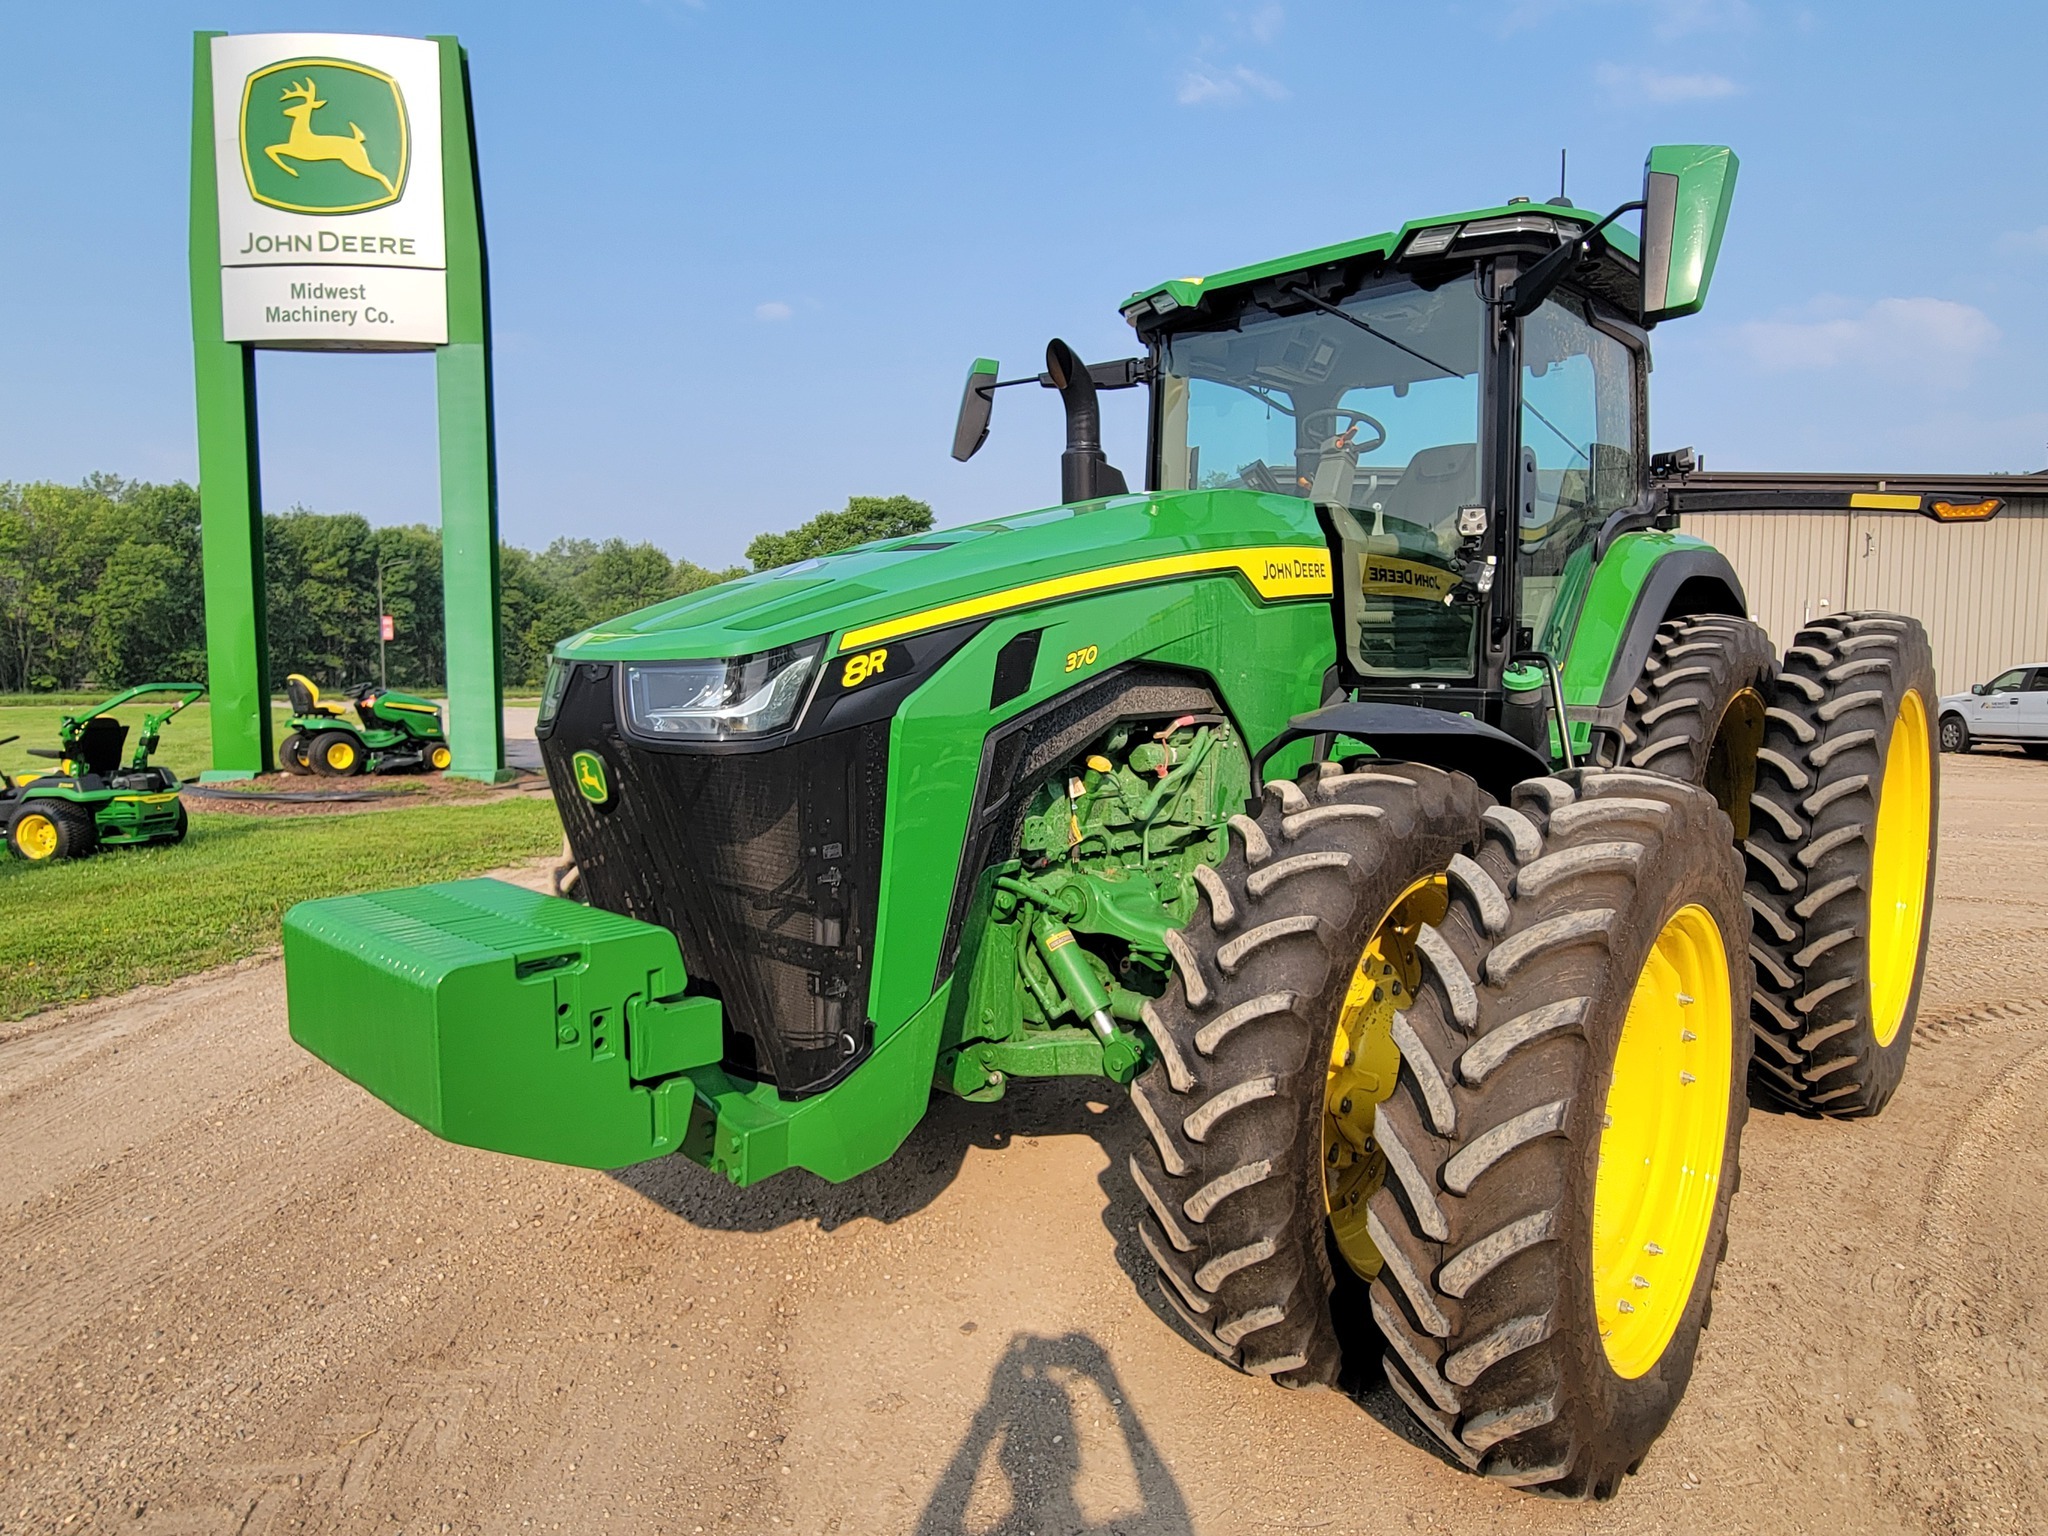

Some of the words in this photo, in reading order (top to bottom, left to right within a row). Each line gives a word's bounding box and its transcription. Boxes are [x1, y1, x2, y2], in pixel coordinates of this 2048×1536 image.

[240, 232, 312, 254] JOHN
[318, 231, 416, 255] DEERE
[291, 283, 366, 300] Midwest
[266, 305, 358, 326] Machinery
[364, 306, 395, 323] Co.
[1263, 560, 1292, 580] JOHN
[1293, 559, 1326, 578] DEERE
[842, 648, 888, 688] 8R
[1065, 644, 1099, 673] 370
